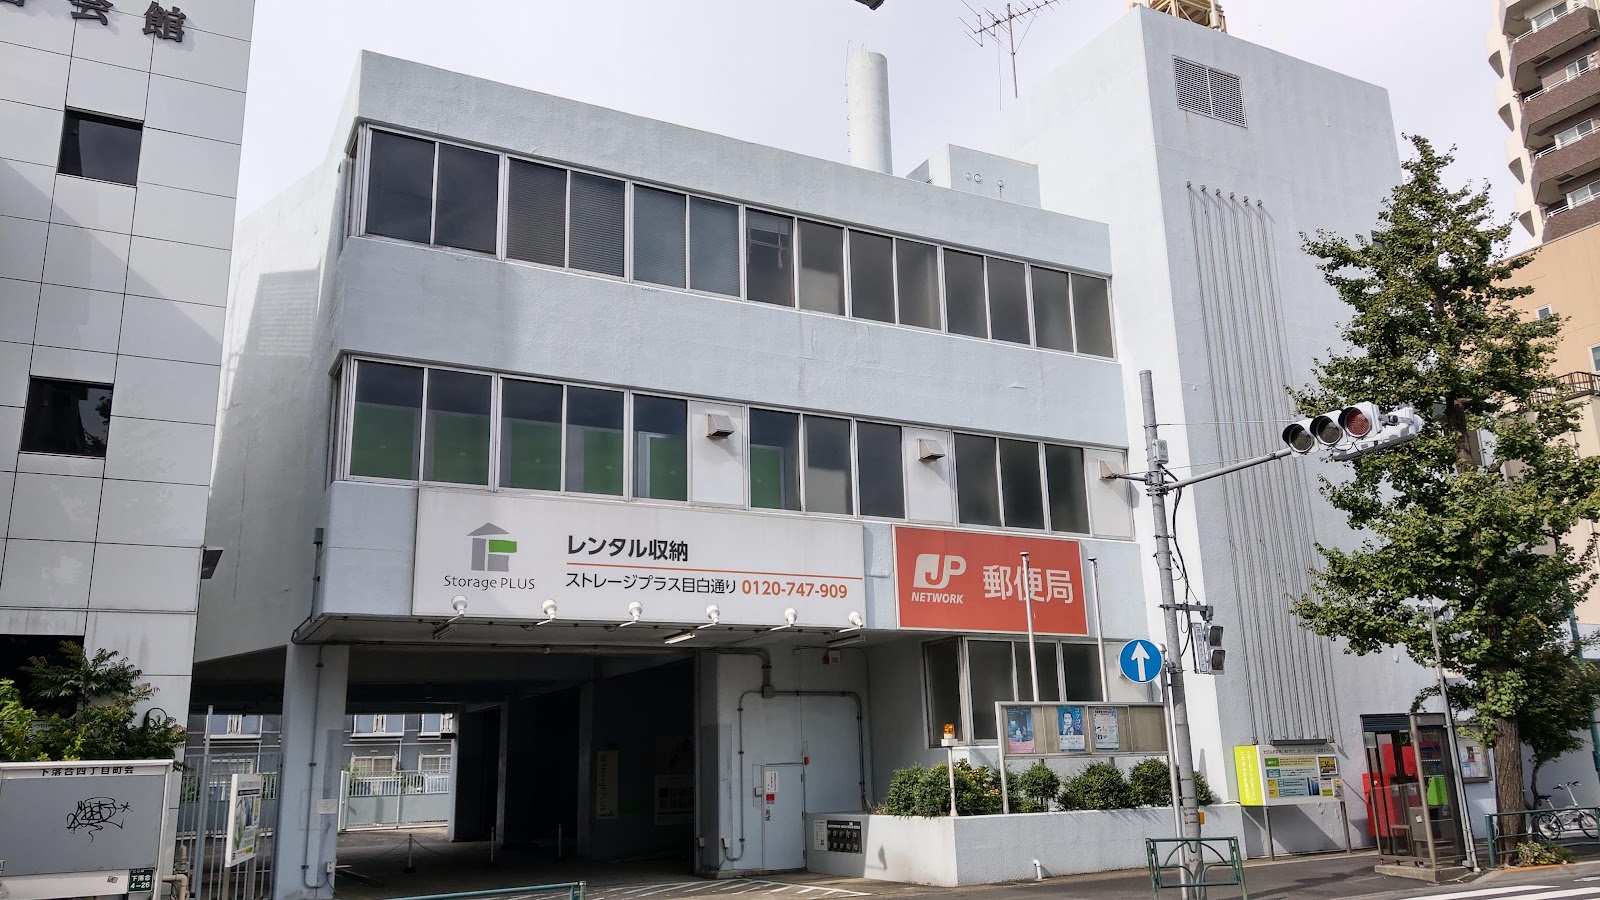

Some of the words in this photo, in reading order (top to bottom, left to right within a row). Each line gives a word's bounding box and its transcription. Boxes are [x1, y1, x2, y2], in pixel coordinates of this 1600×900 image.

[568, 535, 689, 562] レンタル収納
[444, 575, 498, 591] Storage
[500, 577, 535, 590] PLUS
[913, 553, 967, 589] JP
[982, 564, 1074, 604] 郵便局
[566, 572, 736, 594] ストレージプラス目白通り
[741, 580, 848, 598] 0120-747-909
[911, 591, 964, 604] NETWORK
[41, 766, 134, 776] 下落合四丁目町会
